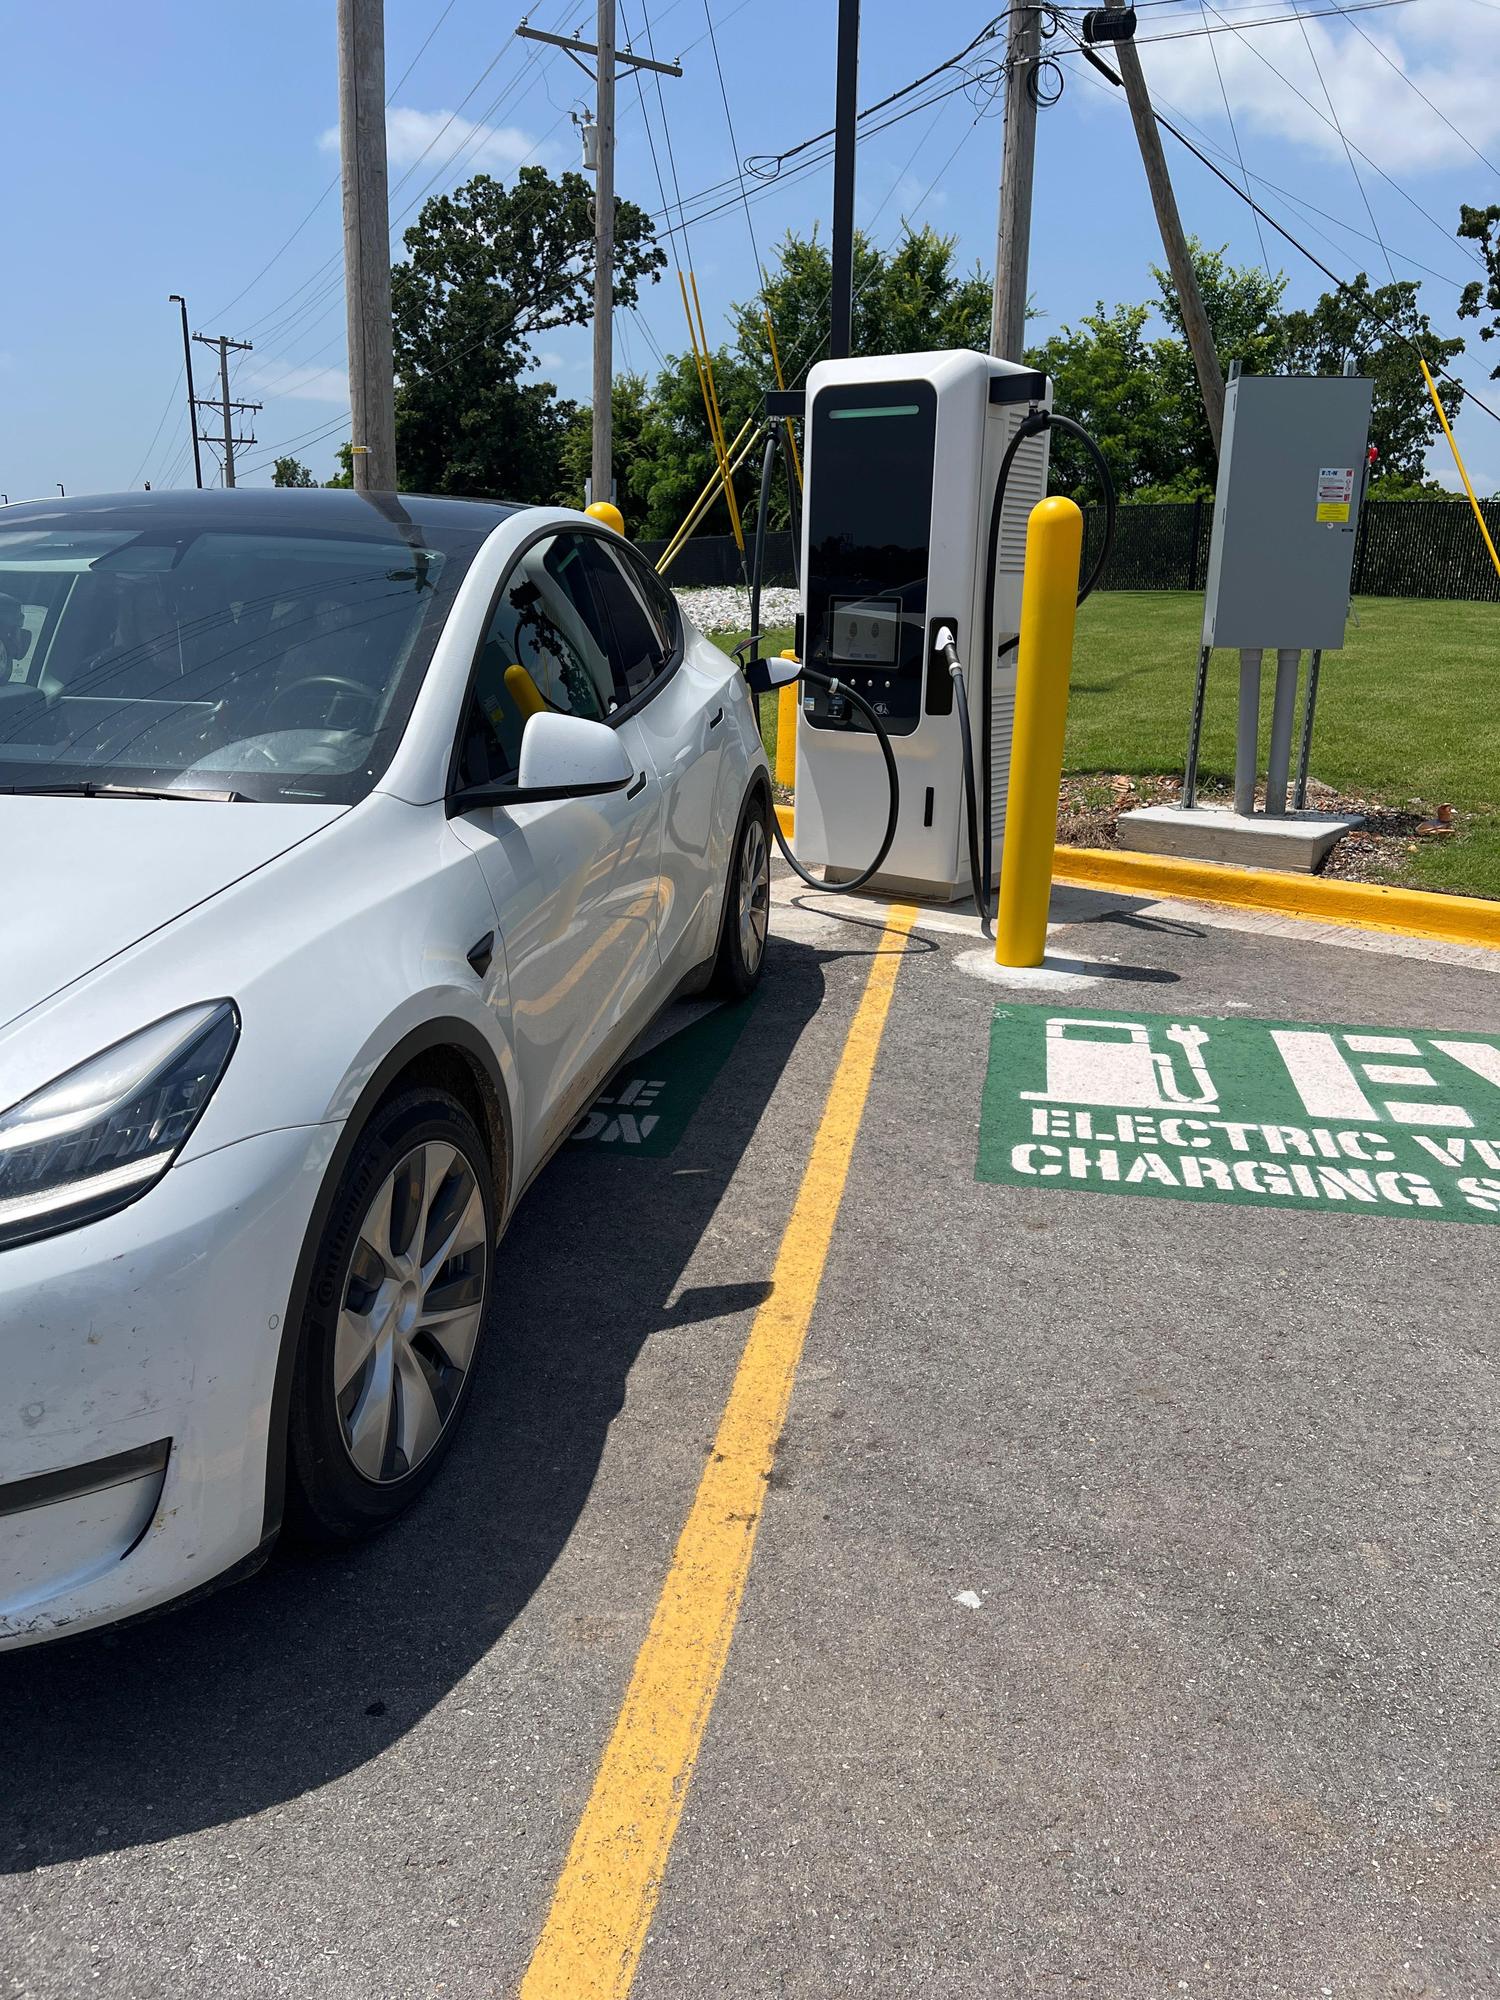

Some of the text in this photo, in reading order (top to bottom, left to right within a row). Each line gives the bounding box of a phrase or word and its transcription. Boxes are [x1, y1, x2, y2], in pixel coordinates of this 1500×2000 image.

[1032, 1108, 1395, 1161] ELECTRIC
[1012, 1144, 1443, 1207] CHARGING
[316, 1164, 374, 1308] Continental
